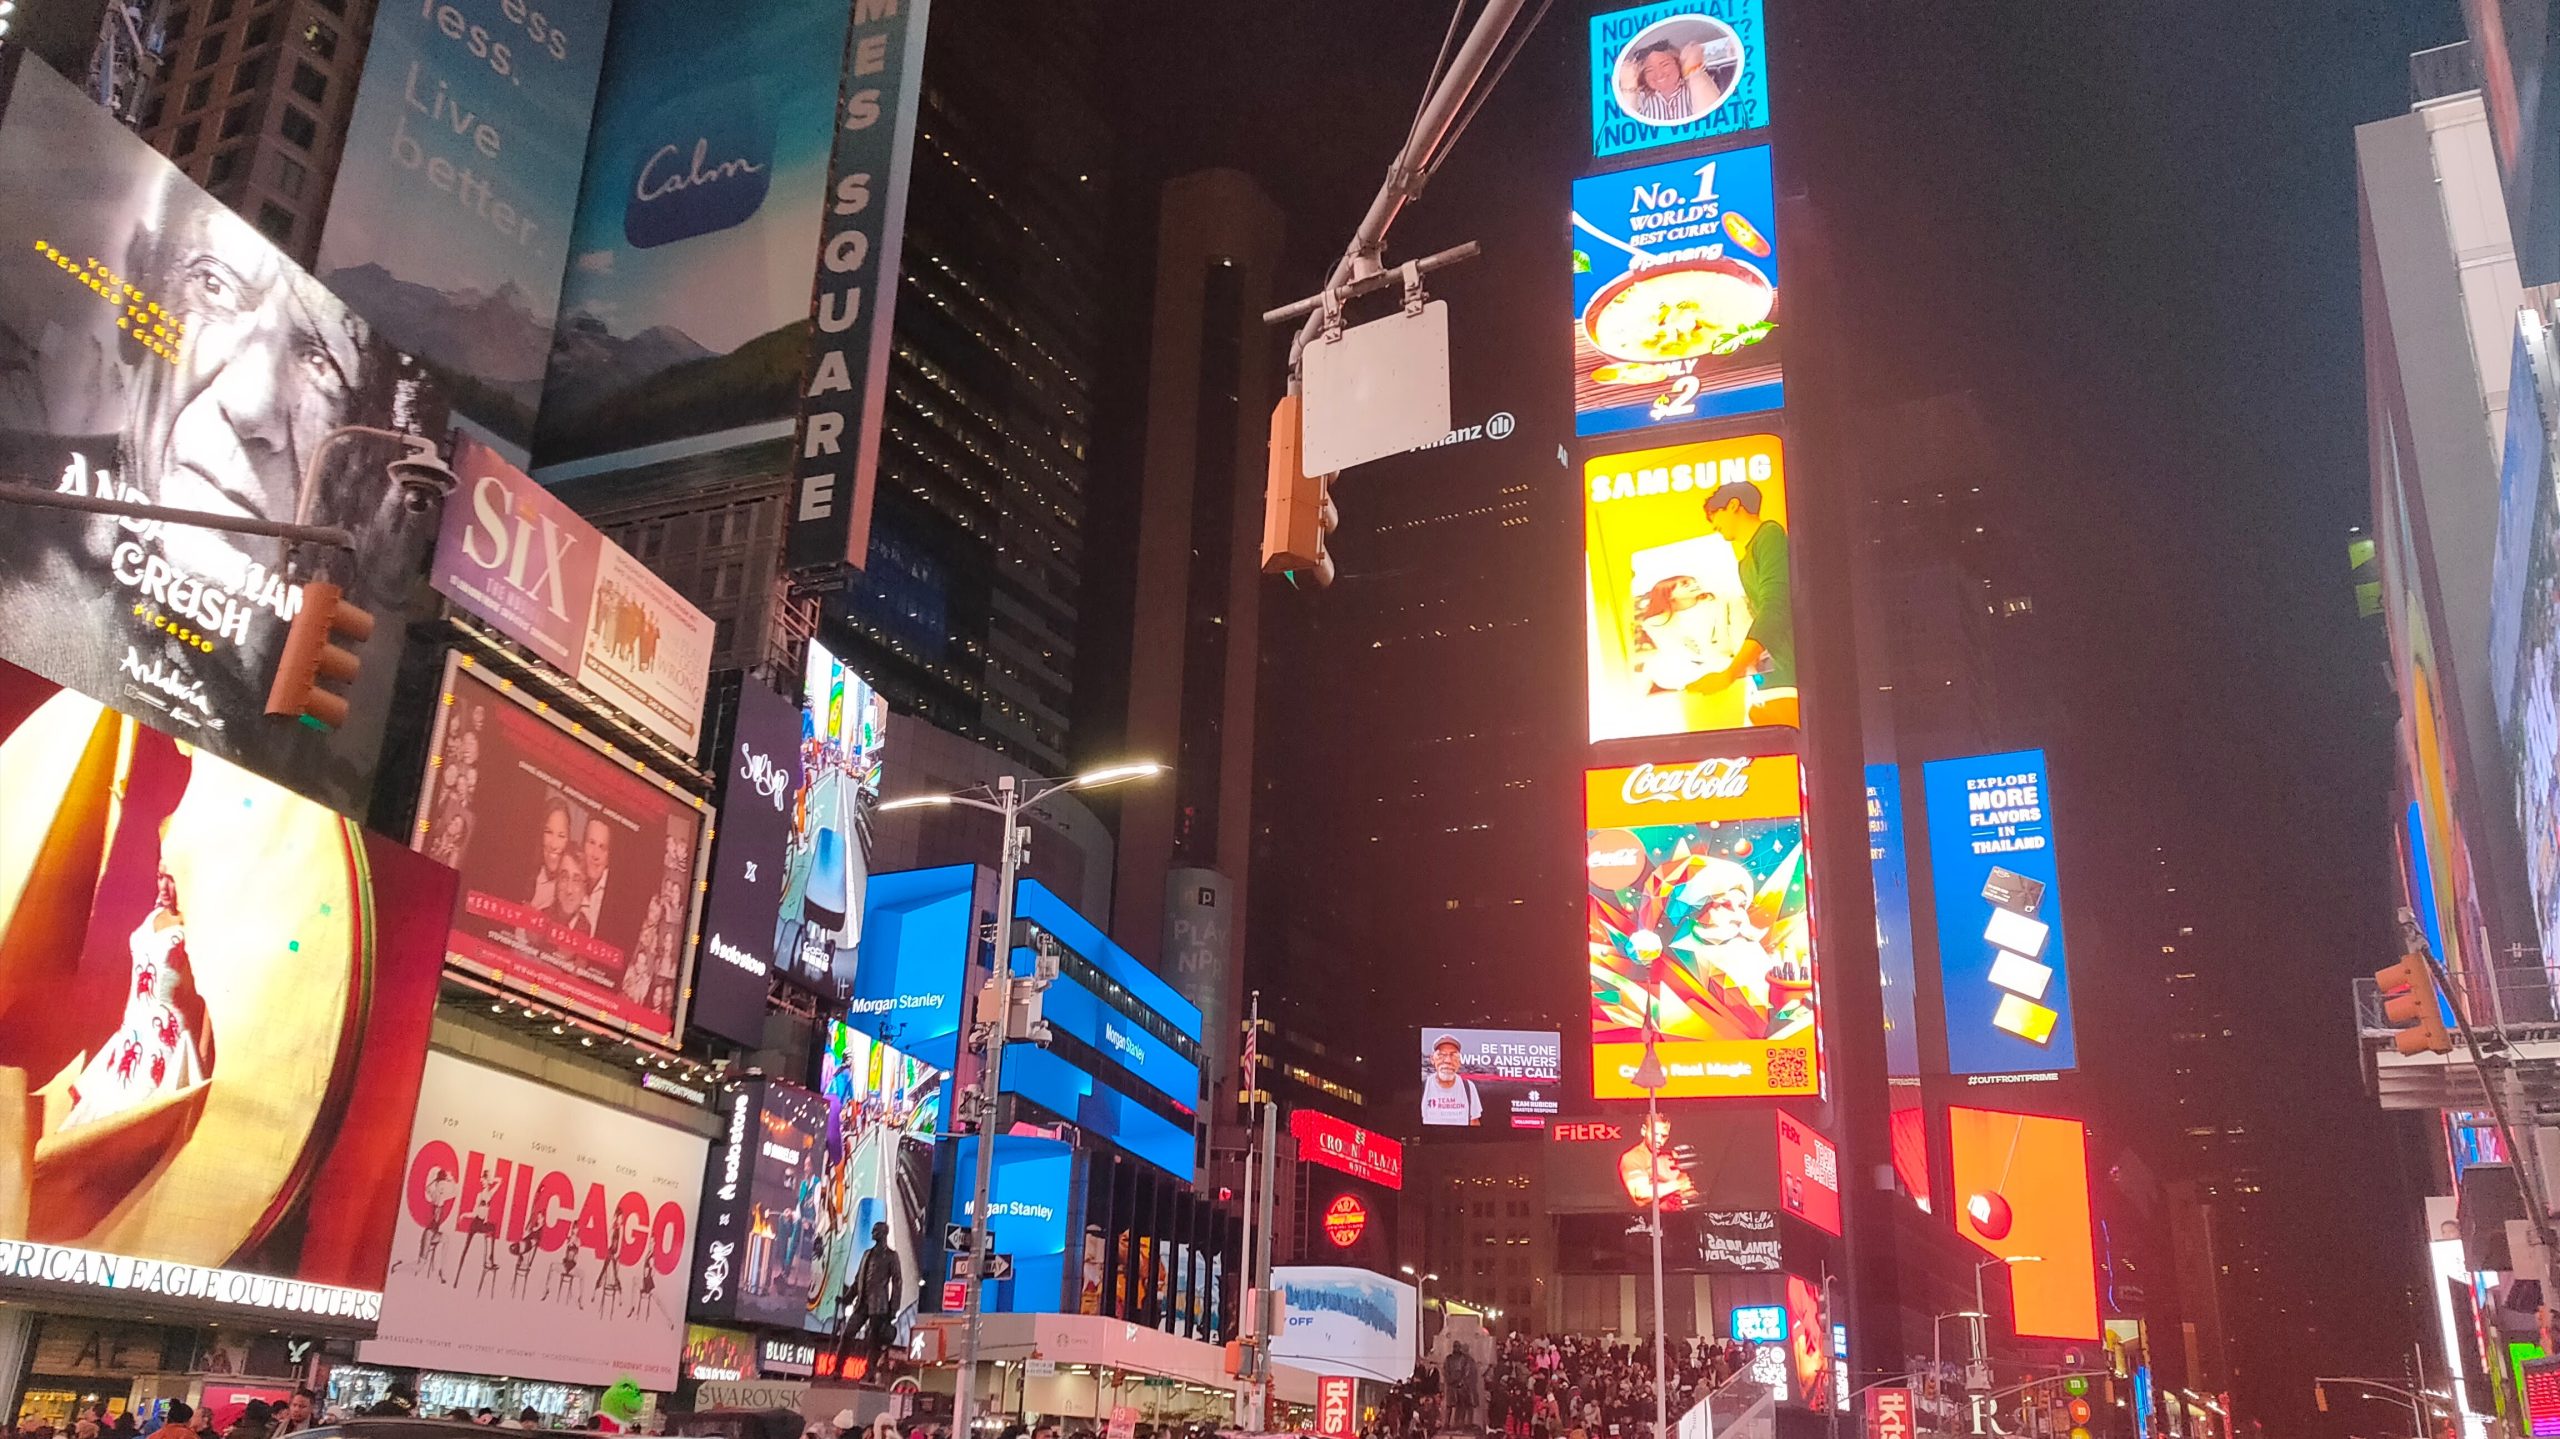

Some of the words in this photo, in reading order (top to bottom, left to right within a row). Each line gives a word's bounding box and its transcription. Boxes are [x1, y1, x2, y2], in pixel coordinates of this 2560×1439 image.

[1602, 11, 1657, 43] NOW
[405, 61, 500, 158] Live
[1604, 121, 1660, 148] NOW
[637, 138, 765, 202] Calm
[1630, 182, 1686, 213] No.
[1690, 161, 1719, 204] 1
[1630, 202, 1720, 231] WORLD'S
[1630, 231, 1667, 248] BEST
[1666, 221, 1720, 242] CURRY
[147, 301, 187, 335] NEVE
[799, 173, 871, 523] SQUARE
[1650, 375, 1700, 421] $2
[1591, 454, 1772, 503] SAMSUNG
[462, 476, 578, 622] SIX
[133, 603, 214, 653] PICASSO
[1621, 756, 1753, 805] Coca-Cola
[1967, 772, 2038, 790] EXPLORE
[1969, 786, 2039, 811] MORE
[1970, 807, 2042, 827] FLAVORS
[1971, 835, 2046, 854] THAILAND
[1998, 825, 2016, 837] IN
[803, 941, 830, 962] GoPro
[852, 997, 897, 1014] Morgan
[899, 992, 945, 1009] Stanley
[1105, 1022, 1127, 1051] Morgan
[1125, 1035, 1146, 1066] Stanley
[1482, 1043, 1498, 1054] BE
[1500, 1044, 1526, 1055] THE
[1528, 1045, 1557, 1056] ONE
[1460, 1054, 1491, 1065] WHO
[1493, 1055, 1557, 1066] ANSWERS
[1497, 1066, 1523, 1078] THE
[1525, 1067, 1558, 1079] CALL
[1968, 1073, 2059, 1086] #OUTFRONTPRIME
[1511, 1100, 1529, 1108] TEAM
[1554, 1123, 1621, 1141] FitRx
[1368, 1149, 1398, 1173] PLAZA
[407, 1139, 686, 1275] CHICAGO
[964, 1200, 1008, 1218] Mgan
[1009, 1200, 1054, 1222] Stanley
[129, 1259, 222, 1300] EAGLE
[229, 1274, 380, 1320] OUTFITTERS
[1289, 1317, 1313, 1327] OFF
[766, 1340, 794, 1363] BLUE
[796, 1345, 816, 1366] FIN
[1327, 1379, 1349, 1435] tkts
